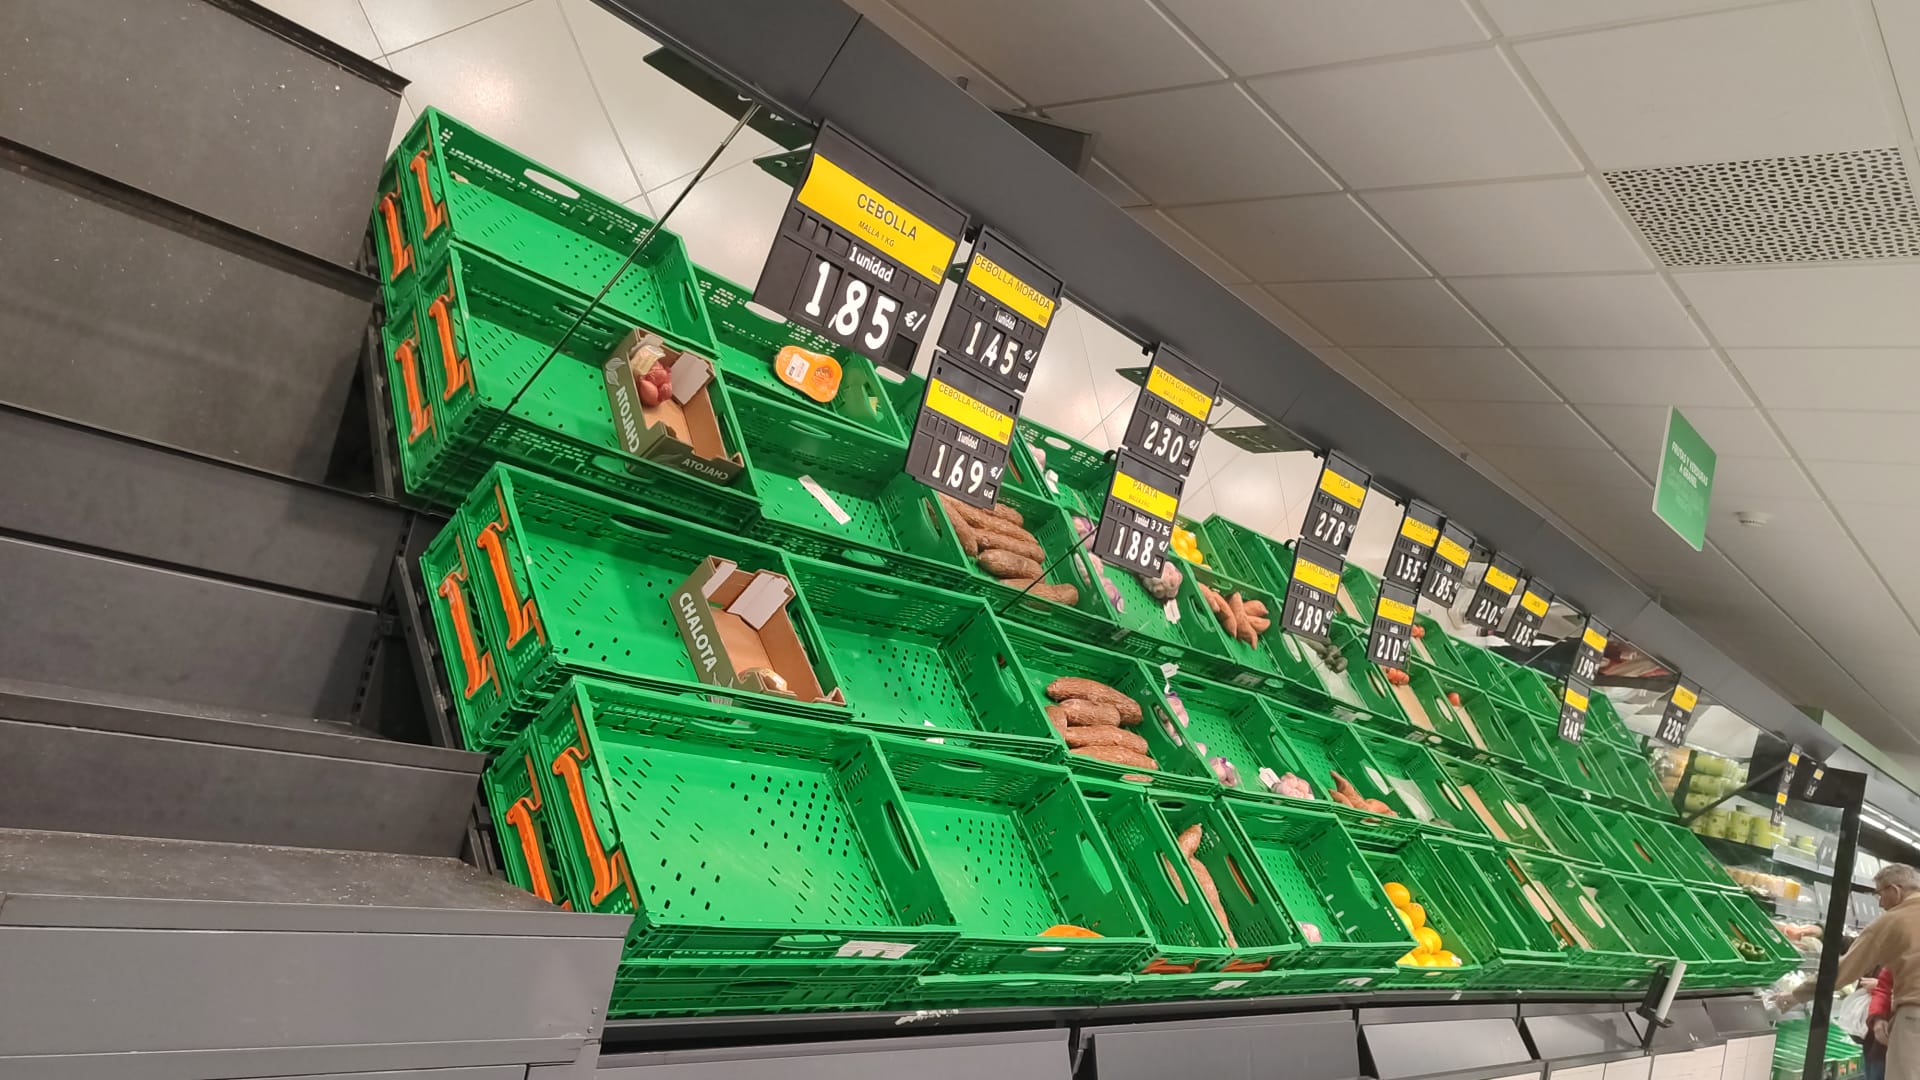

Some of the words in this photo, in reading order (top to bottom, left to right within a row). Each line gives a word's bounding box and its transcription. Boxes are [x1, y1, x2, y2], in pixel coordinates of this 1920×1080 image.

[857, 194, 917, 241] CEBOLLA
[858, 221, 880, 240] MALLA
[885, 237, 895, 248] KG
[974, 255, 1014, 288] CEBOLLA
[1014, 281, 1051, 310] MORADA
[1018, 370, 1029, 382] ud
[938, 384, 971, 407] CEBOLLA
[971, 401, 1003, 424] CHALOTA
[983, 487, 994, 499] ud
[679, 592, 718, 673] CHALOTA
